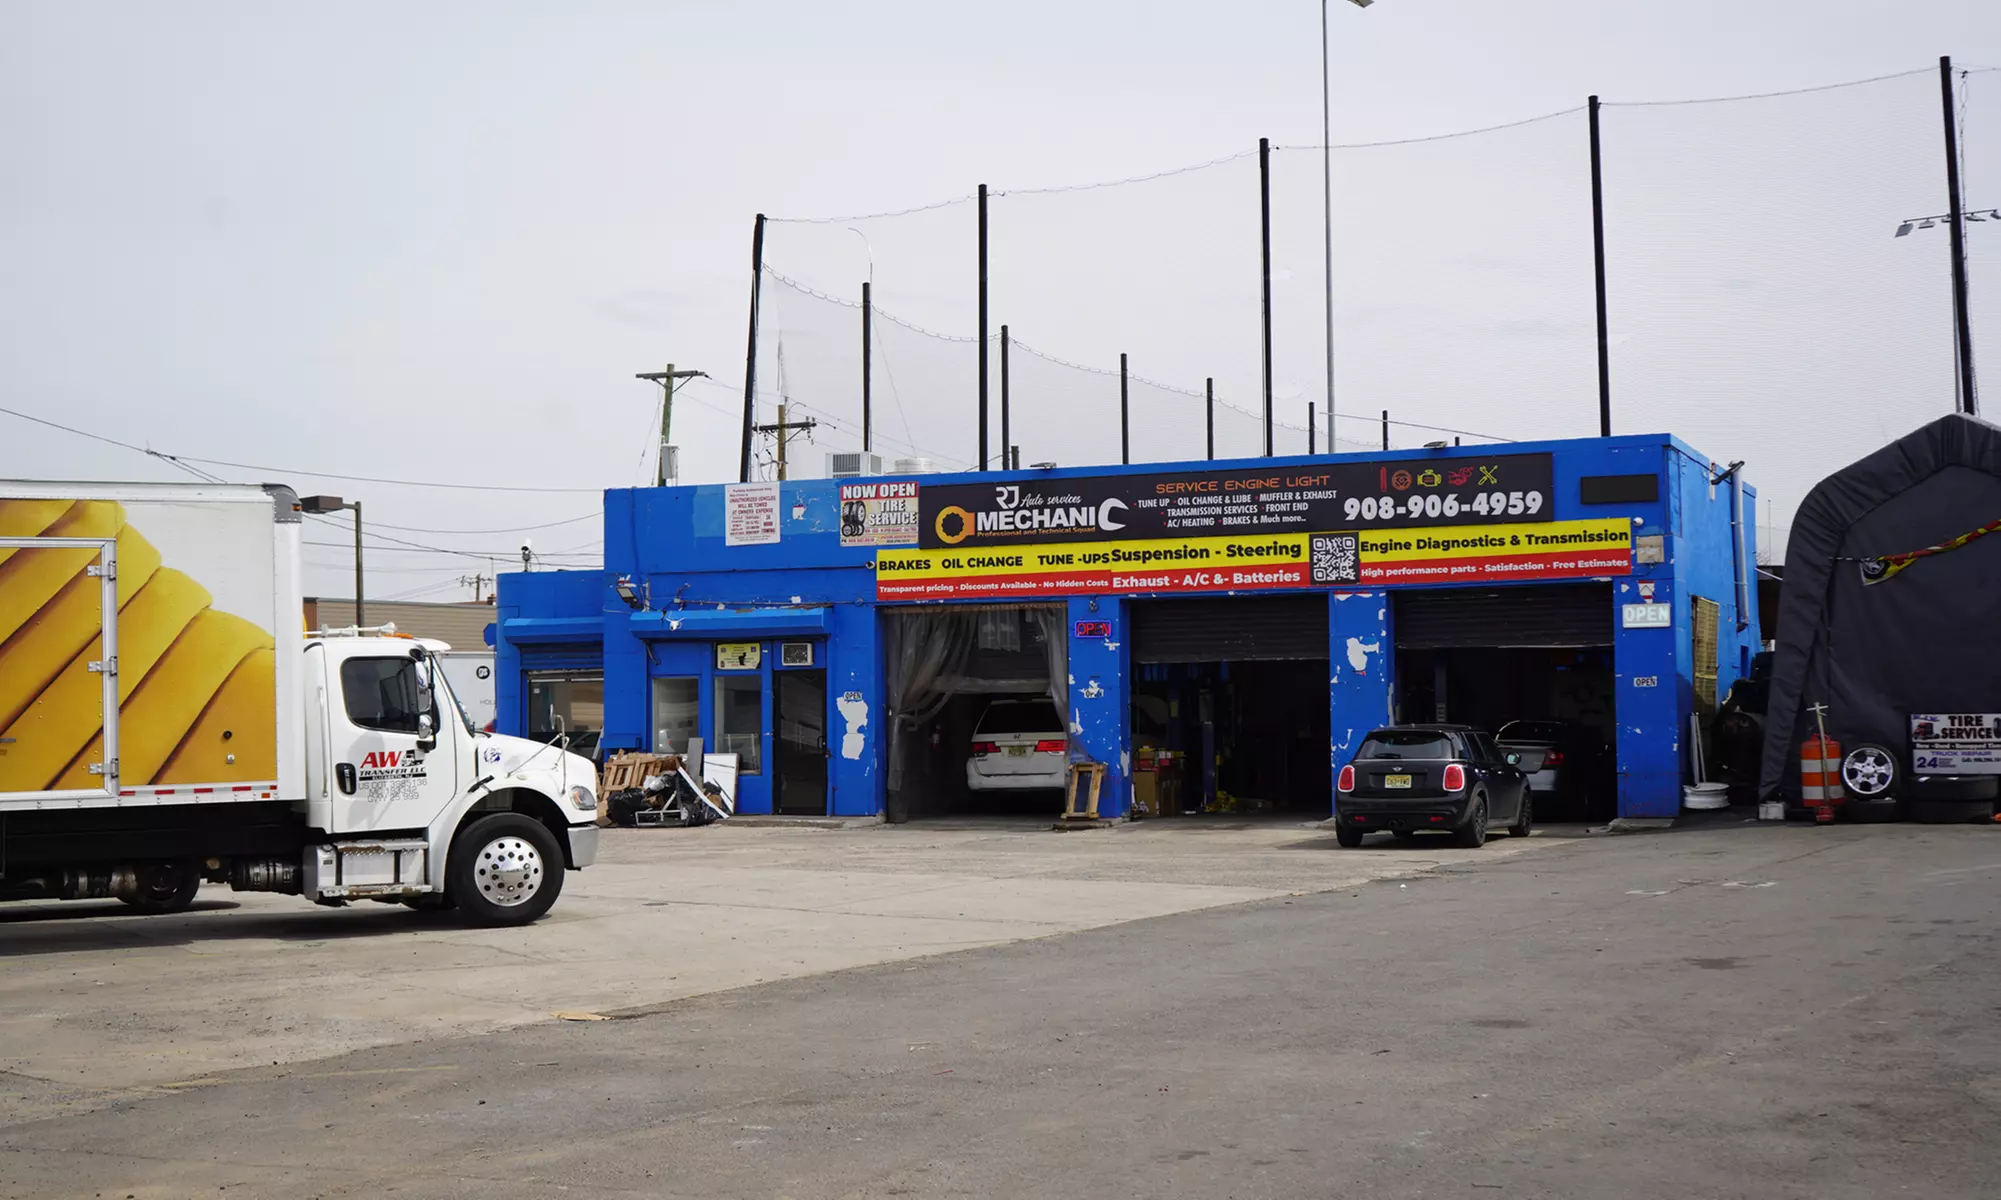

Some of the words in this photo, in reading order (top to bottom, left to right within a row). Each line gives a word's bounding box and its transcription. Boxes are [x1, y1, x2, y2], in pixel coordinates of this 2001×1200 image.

[843, 484, 877, 499] NOW
[880, 483, 916, 498] OPEN
[1156, 481, 1218, 494] SERVICE
[1225, 478, 1280, 490] ENGINE
[1286, 475, 1330, 487] LIGHT
[996, 486, 1019, 509] RJ
[1020, 493, 1043, 507] Auto
[1047, 494, 1082, 505] services
[1138, 499, 1157, 508] TUNE
[1159, 498, 1170, 507] UP
[1177, 497, 1190, 506] OIL
[1192, 496, 1222, 505] CHANGE
[1232, 494, 1251, 503] LUBE
[1259, 492, 1293, 502] MUFFLER
[1295, 491, 1301, 500] &
[1303, 490, 1337, 500] EXHAUST
[880, 500, 906, 512] TIRE
[1167, 506, 1222, 517] TRANSMISSION
[1224, 504, 1258, 514] SERVICES
[1265, 503, 1291, 512] FRONT
[1293, 502, 1308, 511] END
[1344, 490, 1543, 521] 908-906-4959
[868, 512, 917, 526] SERVICE
[1182, 517, 1215, 527] HEATING
[1223, 515, 1251, 525] BRAKES
[1253, 516, 1259, 524] &
[1260, 514, 1280, 523] Much
[976, 529, 1022, 537] Professional
[1360, 539, 1412, 554] Engine
[1416, 534, 1505, 552] Diagnostics
[1510, 535, 1521, 546] &
[1525, 529, 1629, 545] Transmission
[1111, 544, 1210, 564] Suspension
[1226, 541, 1302, 558] Steering
[879, 559, 931, 571] BRAKES
[942, 558, 964, 569] OIL
[967, 556, 1023, 568] CHANGE
[1037, 554, 1074, 566] TUNE
[1361, 567, 1384, 578] High
[1386, 566, 1449, 577] performance
[1450, 565, 1476, 574] parts
[1484, 562, 1545, 572] Satisfaction
[1553, 561, 1576, 570] Free
[1578, 559, 1629, 568] Estimates
[1112, 575, 1171, 588] Exhaust
[1182, 572, 1210, 588] A/C
[1233, 569, 1301, 585] Batteries
[879, 585, 925, 594] Transparent
[926, 583, 954, 593] pricing
[960, 583, 999, 591] Discounts
[1000, 581, 1037, 589] Available
[1056, 579, 1084, 588] Hidden
[1086, 579, 1109, 587] Costs
[1626, 606, 1669, 622] OPEN
[1077, 623, 1111, 635] OPEN
[1635, 678, 1656, 686] OPEN
[845, 692, 861, 700] OPEN
[1948, 715, 1983, 727] TIRE
[1941, 727, 1993, 740] SERVICE
[360, 751, 402, 769] AW
[1916, 756, 1938, 769] 24
[359, 768, 408, 777] TRANSFER
[358, 782, 370, 790] US
[371, 781, 387, 789] DOT
